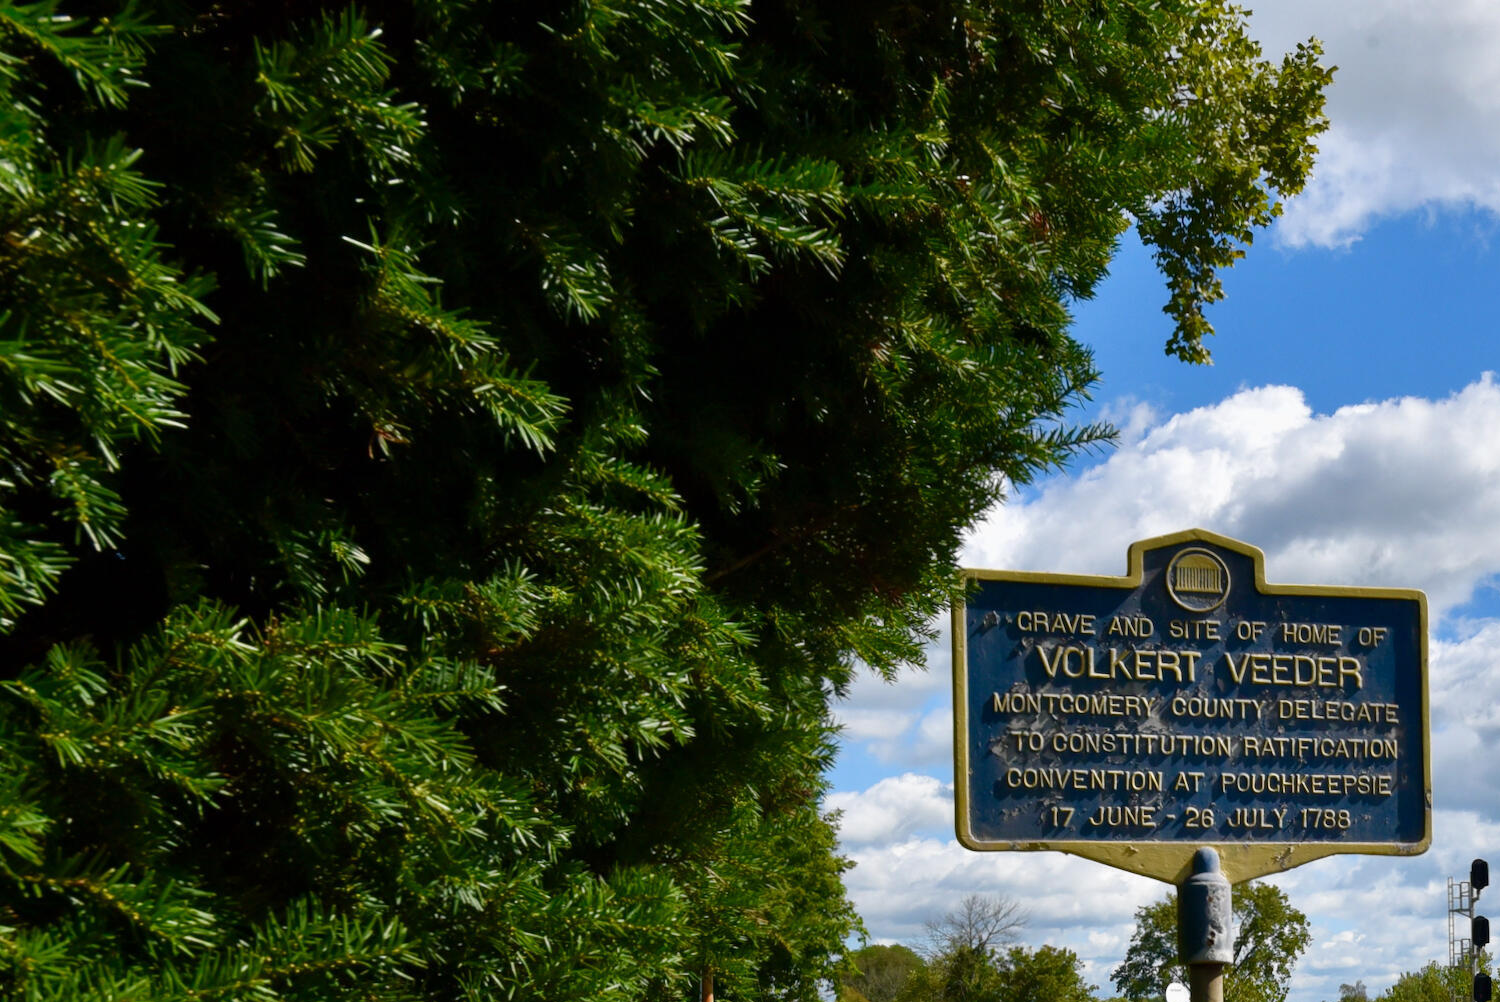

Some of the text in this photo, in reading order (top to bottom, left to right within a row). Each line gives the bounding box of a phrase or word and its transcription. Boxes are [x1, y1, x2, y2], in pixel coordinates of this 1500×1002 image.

[1017, 611, 1387, 647] GRAVE AND SITE OF HOME OF
[1036, 645, 1363, 688] VOLKERT VEEDER
[993, 692, 1399, 723] MONTGOMERY COUNTY DELEGATE
[1010, 731, 1398, 760] TO CONSTITUTION RATIFICATION
[1007, 767, 1392, 795] CONVENTION AT POUGHKEEPSIE
[1050, 806, 1075, 827] 17
[1088, 806, 1157, 827] JUNE
[1185, 806, 1214, 828] 26
[1227, 807, 1288, 828] JULY
[1301, 808, 1351, 829] 1788
